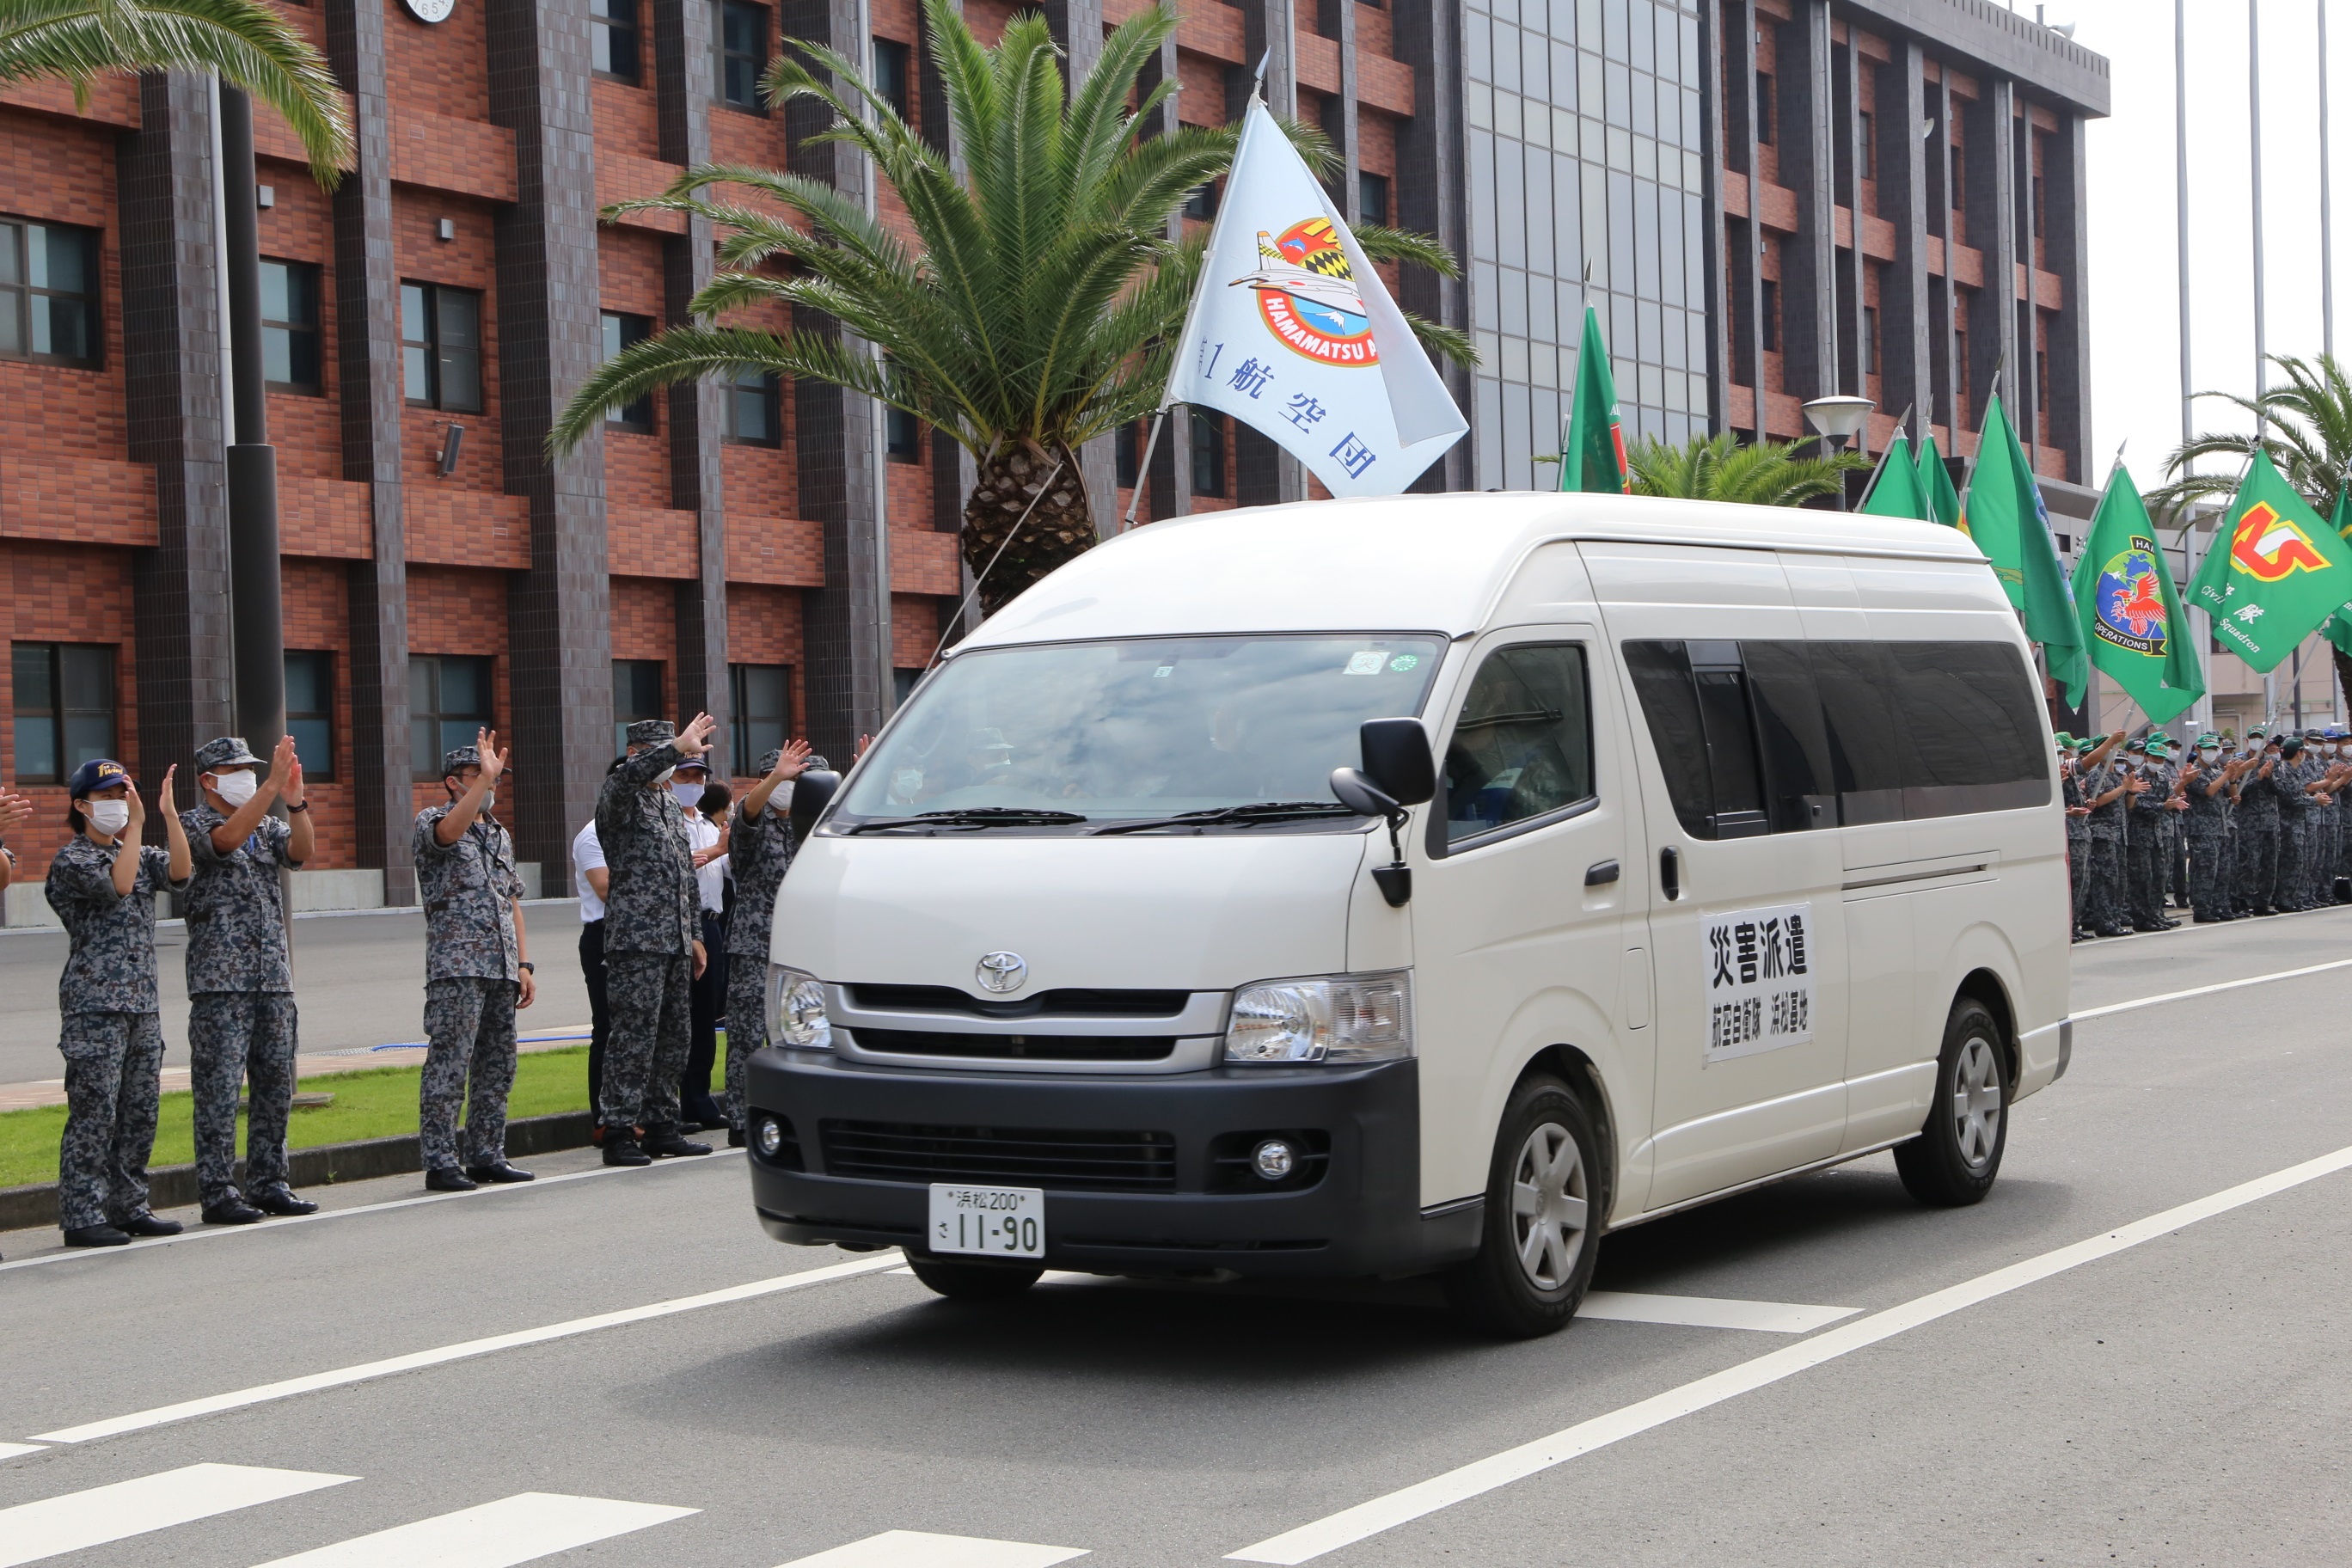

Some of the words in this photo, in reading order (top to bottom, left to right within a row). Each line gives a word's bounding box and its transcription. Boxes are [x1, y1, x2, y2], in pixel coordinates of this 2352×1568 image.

[421, 3, 428, 15] 6
[432, 2, 438, 14] 5
[1265, 297, 1364, 360] HAMAMATSU
[2094, 622, 2148, 651] OPERATIONS
[2201, 585, 2226, 604] Civil
[2219, 617, 2261, 653] Squadron
[1710, 914, 1807, 989] 災害派遣
[1712, 995, 1761, 1049] 航空自衛隊
[1770, 989, 1808, 1036] 浜松基地
[959, 1213, 1037, 1252] 11-90
